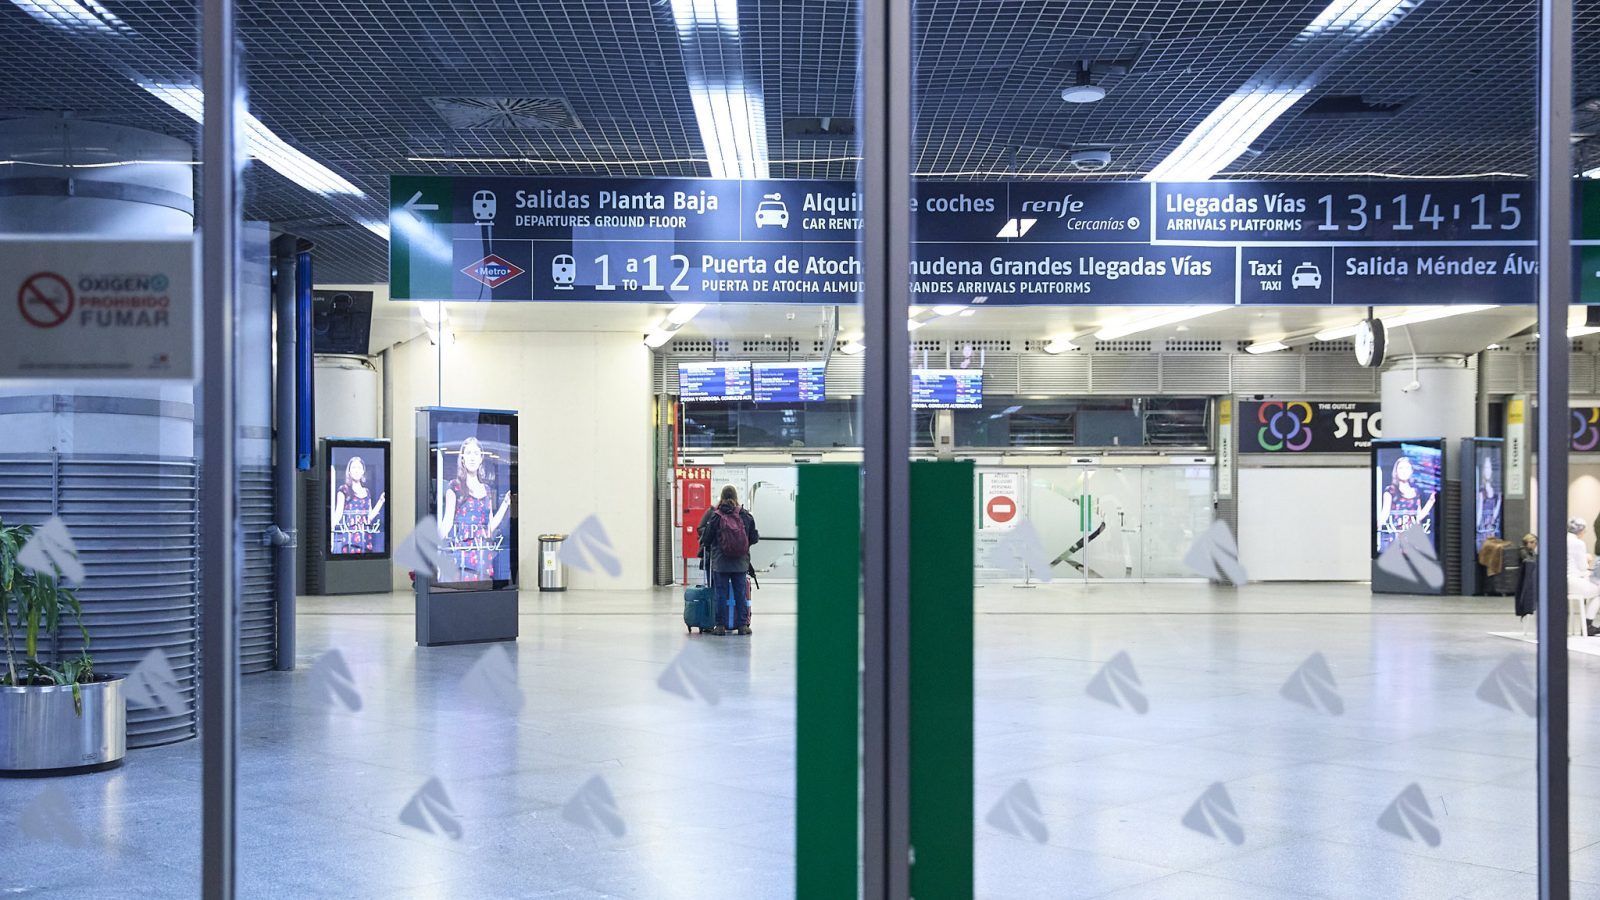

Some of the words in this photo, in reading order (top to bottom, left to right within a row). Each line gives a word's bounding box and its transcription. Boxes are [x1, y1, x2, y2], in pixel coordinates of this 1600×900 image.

[515, 189, 590, 210] Salidas
[599, 190, 665, 210] Planta
[674, 191, 718, 214] Baja
[802, 193, 864, 215] Alquil
[926, 194, 995, 213] coches
[1022, 194, 1084, 218] renfe
[1166, 194, 1258, 216] Llegadas
[1263, 193, 1306, 213] Vías
[515, 215, 590, 227] DEPARTURES
[594, 216, 645, 227] GROUND
[649, 216, 687, 228] FLOOR
[802, 218, 826, 230] CAR
[829, 218, 865, 230] RENTA
[1067, 217, 1125, 230] Cercanías
[1166, 219, 1226, 231] ARRIVALS
[1230, 219, 1303, 231] PLATFORMS
[479, 266, 507, 276] Metro
[594, 254, 616, 291] 1
[626, 258, 638, 273] a
[642, 254, 690, 291] 12
[702, 255, 767, 274] Puerta
[774, 255, 799, 274] de
[805, 256, 865, 275] Atoch
[908, 256, 983, 275] mudena
[990, 257, 1072, 275] Grandes
[1079, 257, 1166, 280] Llegadas
[1171, 256, 1212, 276] Vías
[1248, 260, 1283, 276] Taxi
[1345, 257, 1409, 276] Salida
[1416, 254, 1496, 275] Méndez
[1503, 253, 1540, 275] Álva
[622, 279, 638, 291] TO
[702, 279, 749, 292] PUERTA
[752, 280, 769, 292] DE
[772, 281, 820, 293] ATOCHA
[823, 281, 865, 293] ALMUD
[908, 282, 954, 293] RANDES
[957, 282, 1016, 293] ARRIVALS
[1020, 282, 1091, 293] PLATFORMS
[1260, 281, 1282, 291] TAXI
[79, 296, 170, 308] PROHIBIDO
[80, 310, 170, 327] FUMAR
[1333, 411, 1383, 438] STO
